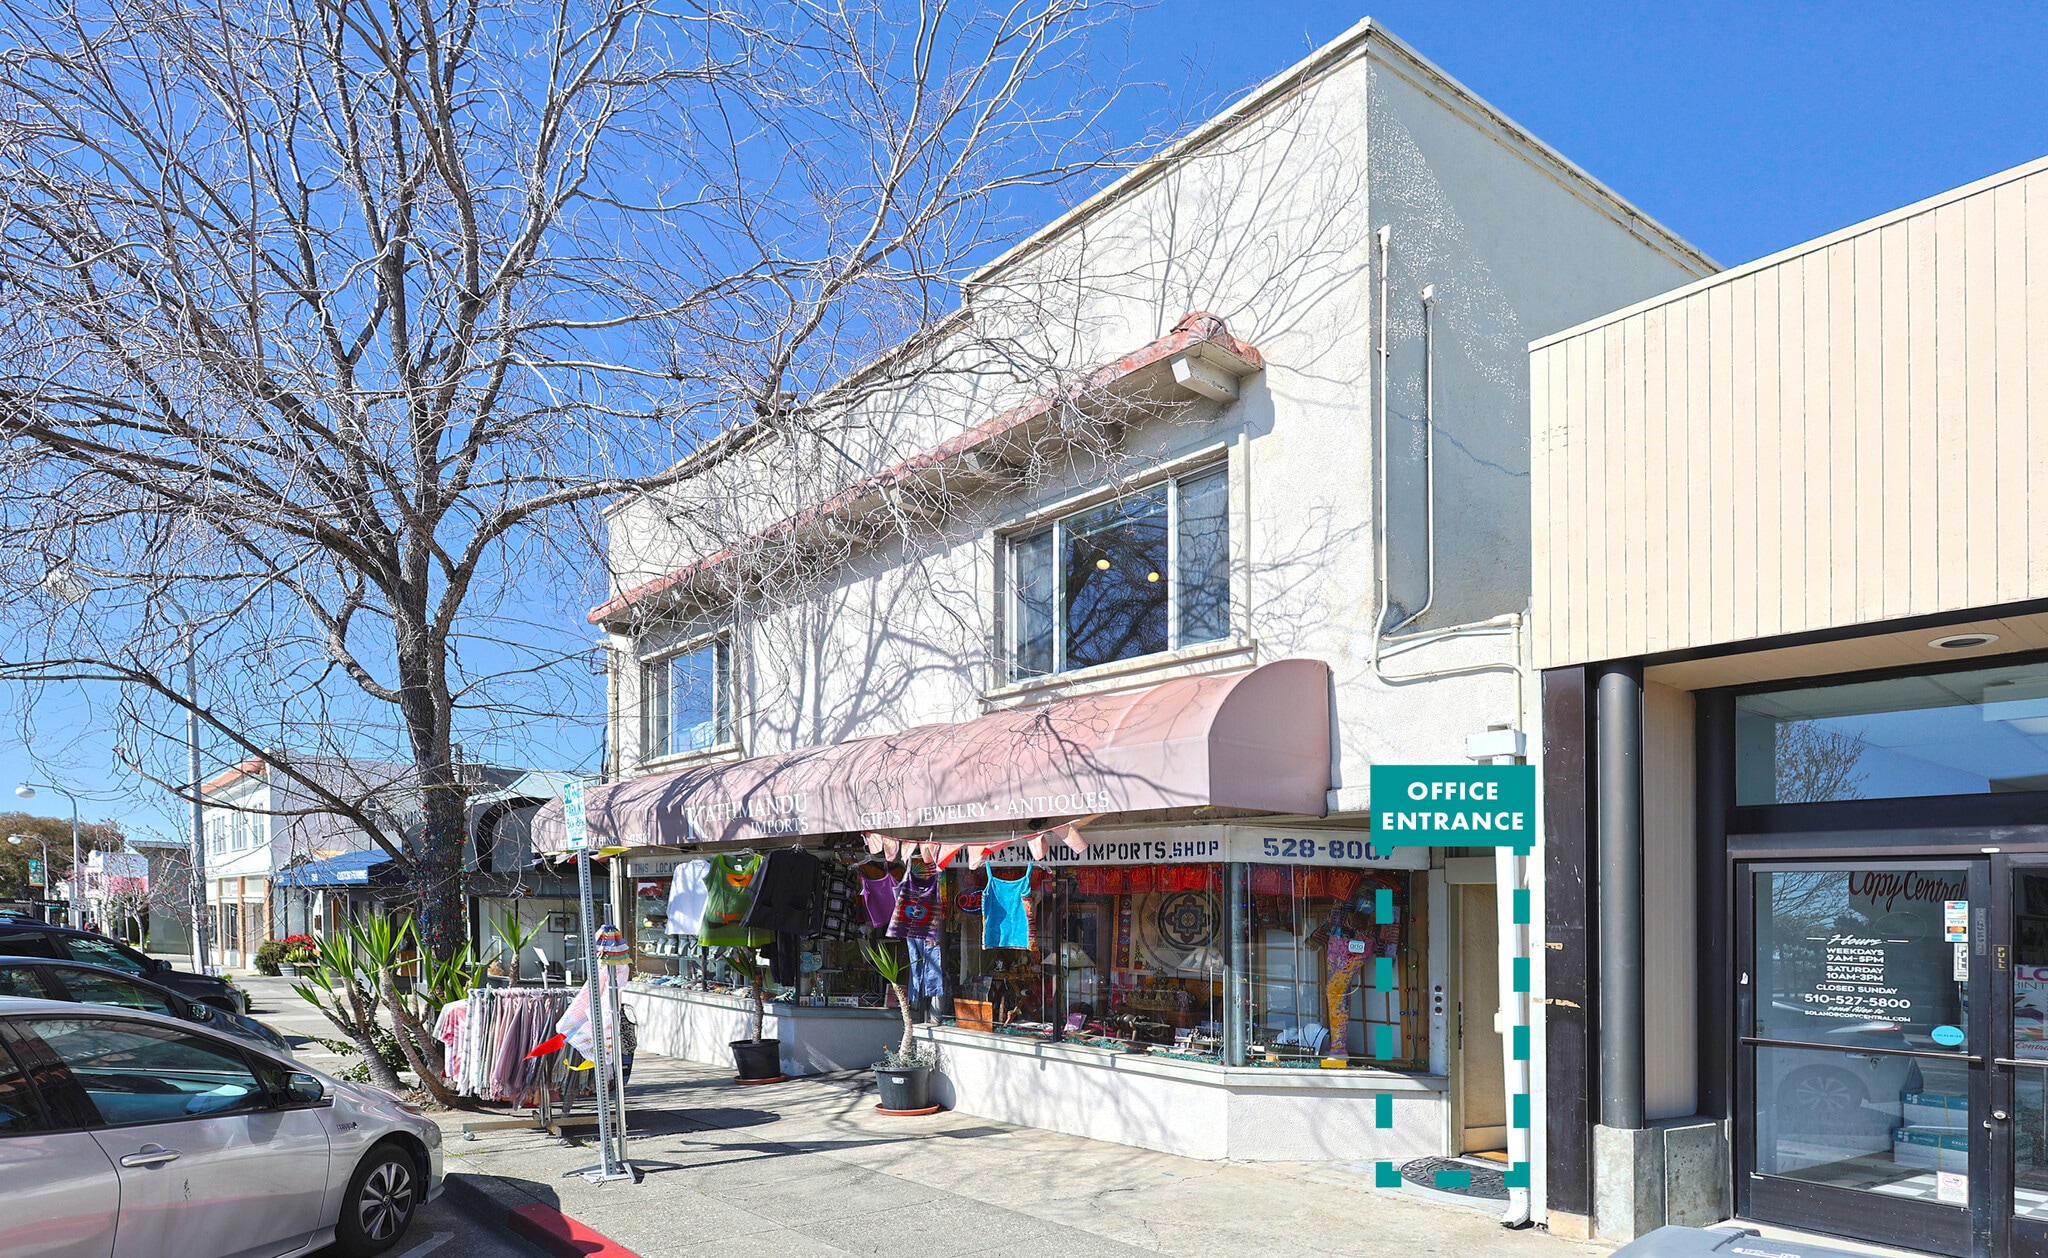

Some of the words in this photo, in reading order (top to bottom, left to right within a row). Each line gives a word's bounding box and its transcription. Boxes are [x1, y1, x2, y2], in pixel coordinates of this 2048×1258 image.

[860, 809, 901, 827] GIFTS
[917, 801, 988, 825] JEWELRY
[1007, 790, 1110, 814] ANTIQUES
[685, 793, 809, 840] KATHMANDU
[750, 816, 809, 836] IMPORTS
[1263, 837, 1394, 861] 528-800
[634, 863, 649, 874] THIS
[1849, 871, 1902, 912] Copy
[1904, 871, 1968, 903] Central
[957, 893, 983, 908] OPE
[1827, 933, 1882, 946] Hours
[1826, 947, 1885, 956] WEEKDAYS
[1826, 954, 1884, 964] 9AM-5PM
[1956, 946, 1968, 971] PULL
[1997, 946, 2006, 969] PULL
[1825, 972, 1884, 982] 10AM-3PM
[1826, 965, 1884, 974] SATURDAY
[1815, 984, 1856, 993] CLOSED
[1857, 985, 1898, 995] SUNDAY
[1804, 993, 1911, 1009] 510-527-5800
